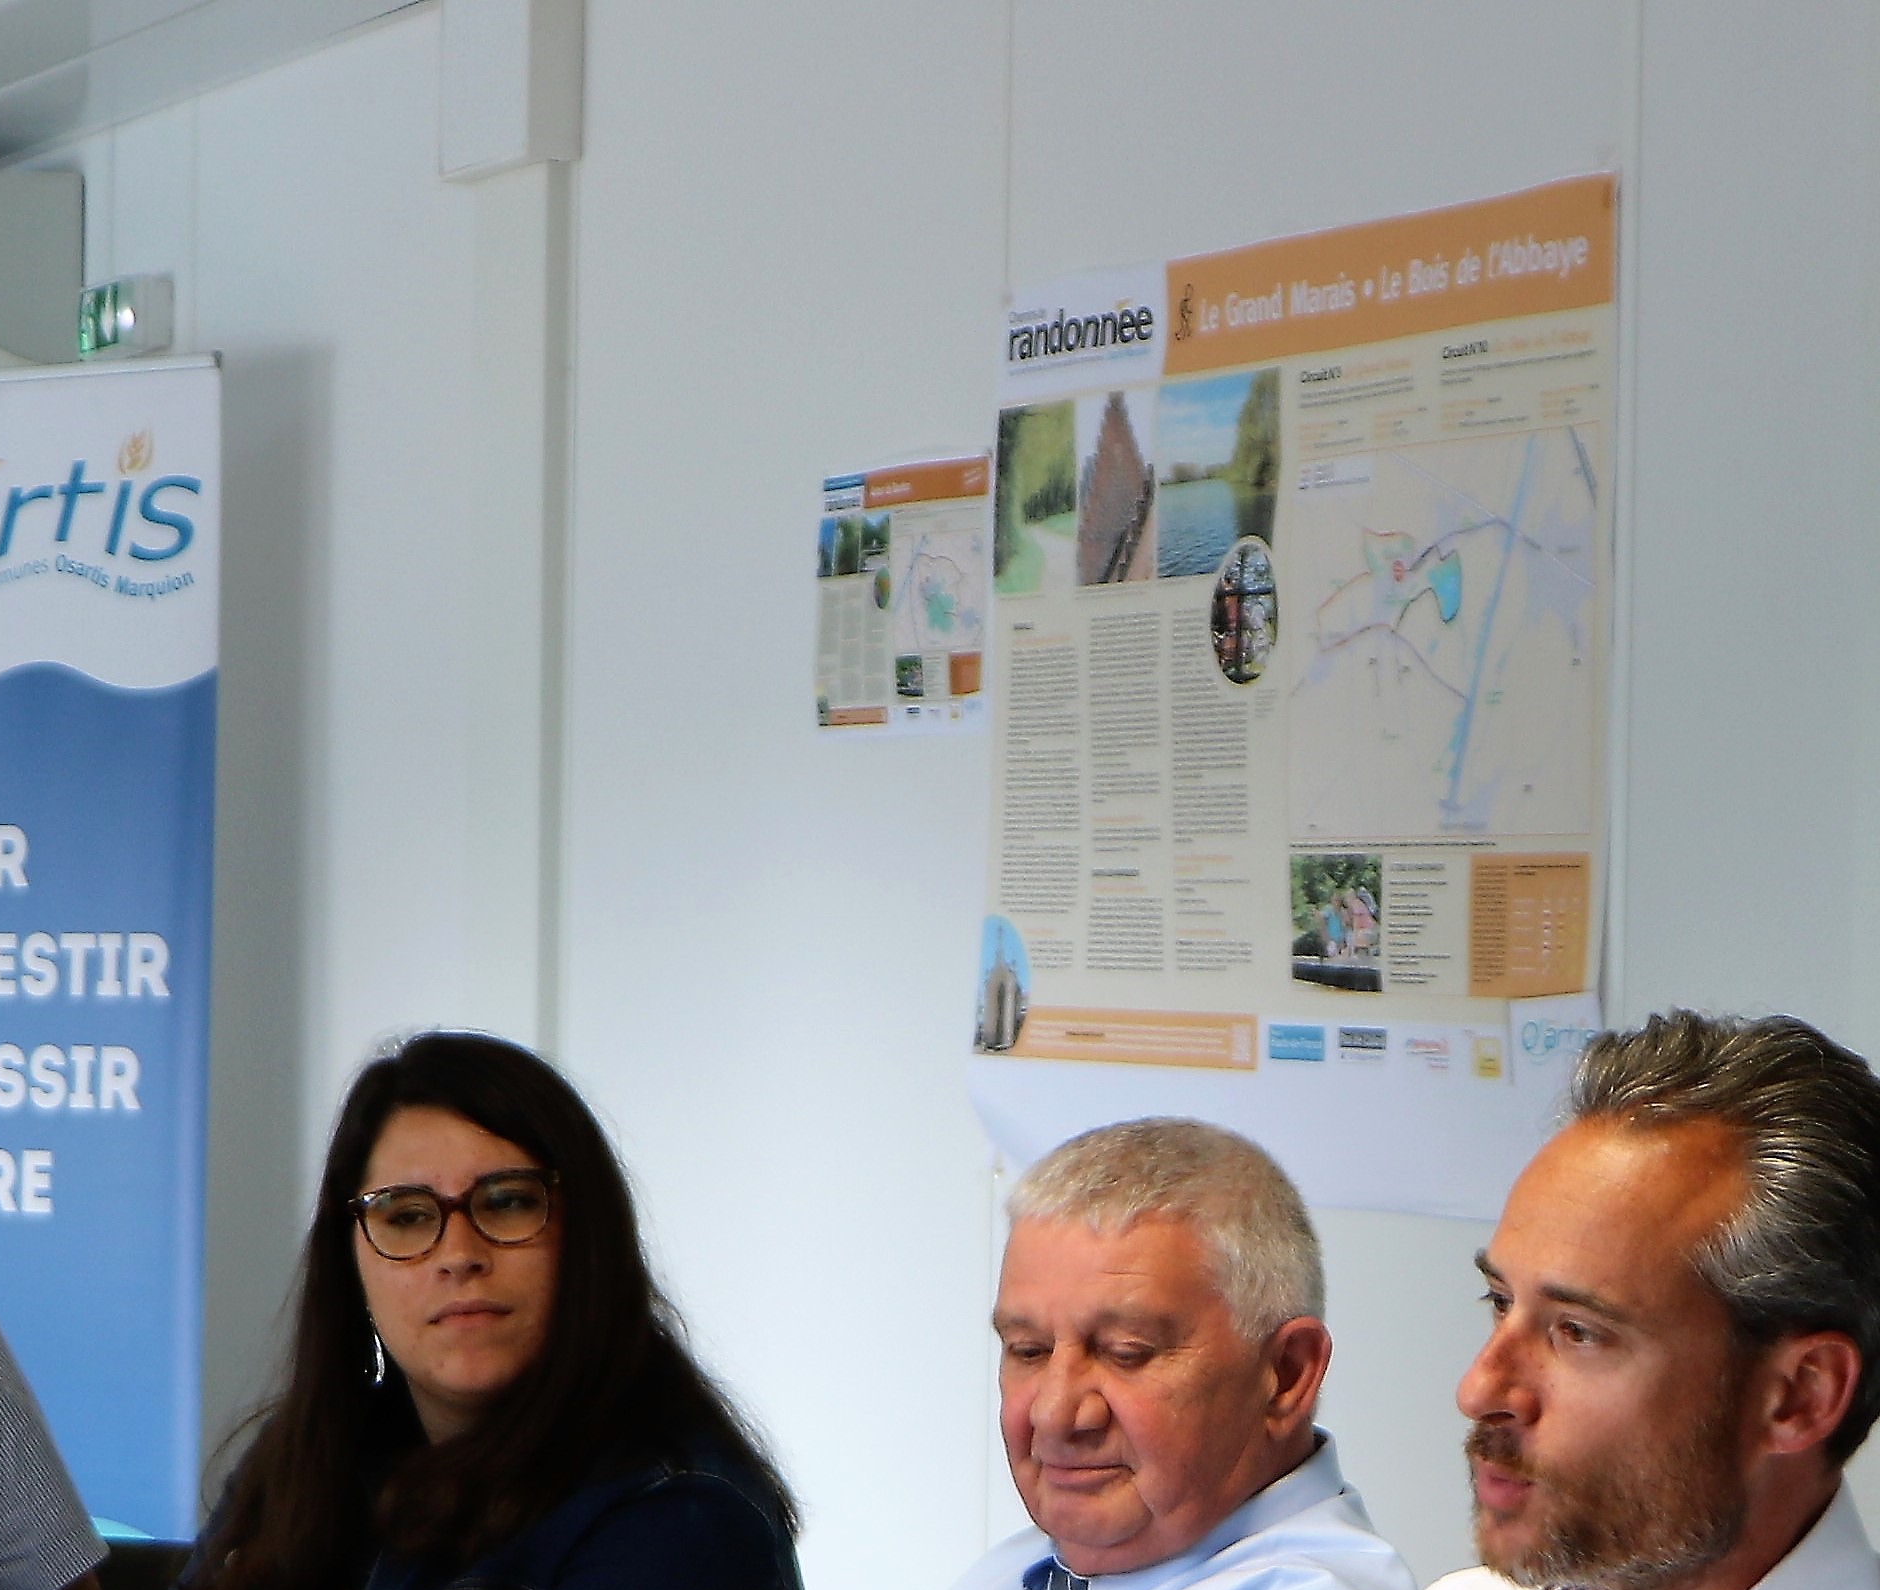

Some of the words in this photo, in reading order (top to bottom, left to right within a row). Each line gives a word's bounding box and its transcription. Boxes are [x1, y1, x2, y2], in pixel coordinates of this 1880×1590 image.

[1199, 299, 1220, 331] Le
[1226, 282, 1284, 328] Grand
[1290, 272, 1356, 316] Marais
[1380, 265, 1402, 301] Le
[1408, 252, 1450, 295] Bois
[1456, 246, 1481, 286] de
[55, 553, 110, 588] Osartis
[116, 571, 195, 601] Marquion
